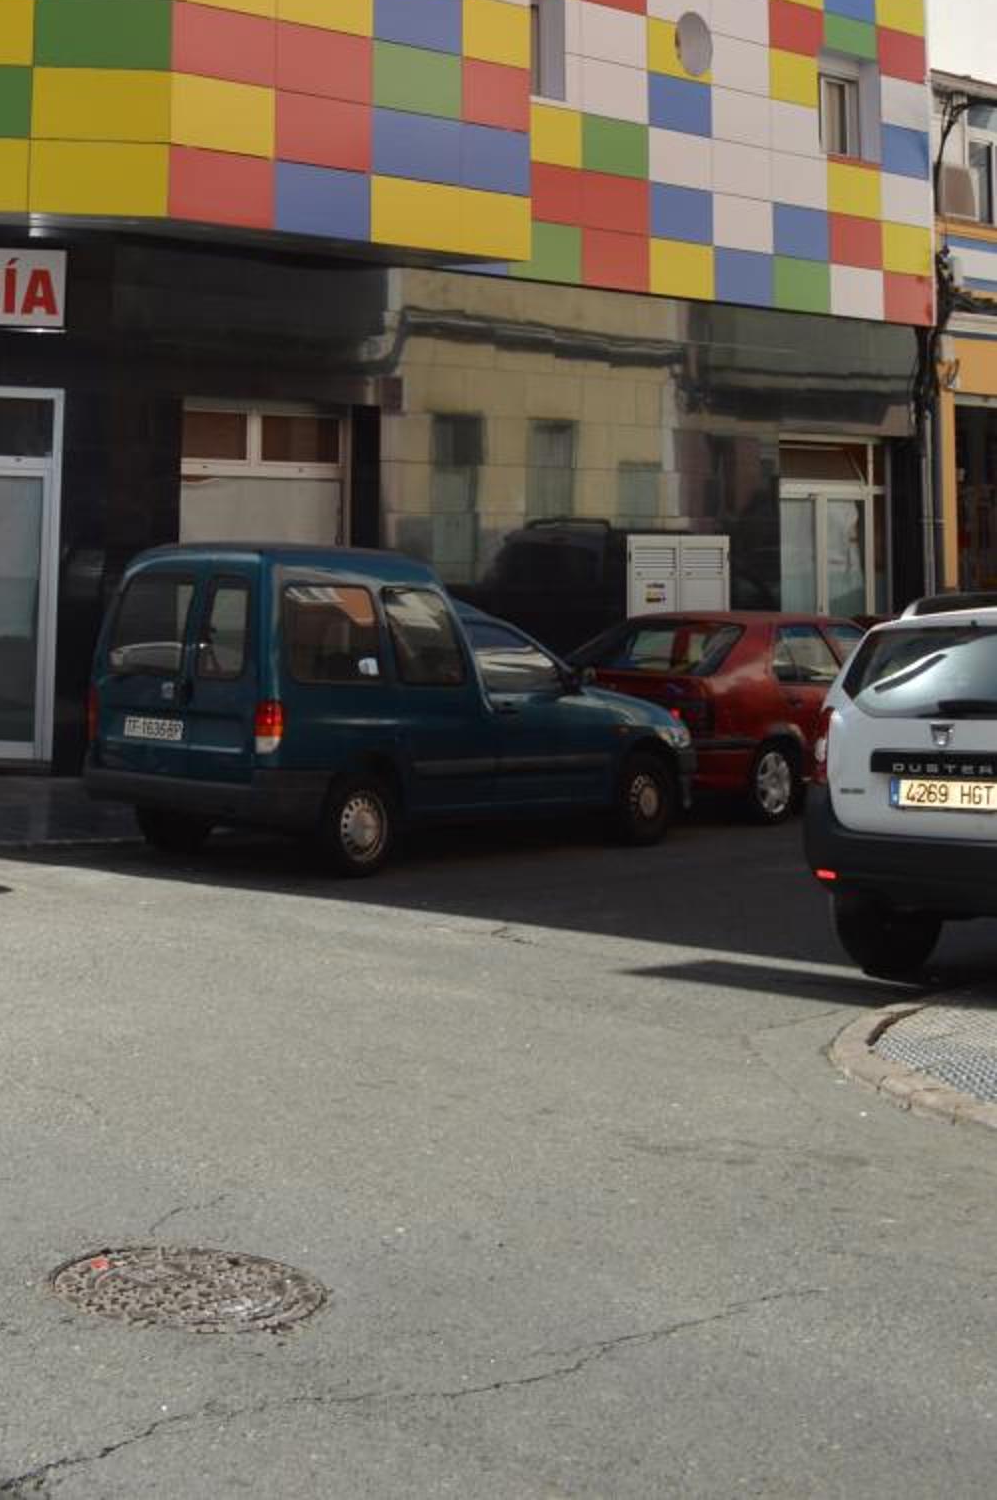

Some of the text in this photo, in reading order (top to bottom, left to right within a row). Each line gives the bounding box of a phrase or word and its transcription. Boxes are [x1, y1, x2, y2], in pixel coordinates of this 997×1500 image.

[892, 763, 994, 775] DUSTER
[906, 782, 995, 805] 4269 HGT
